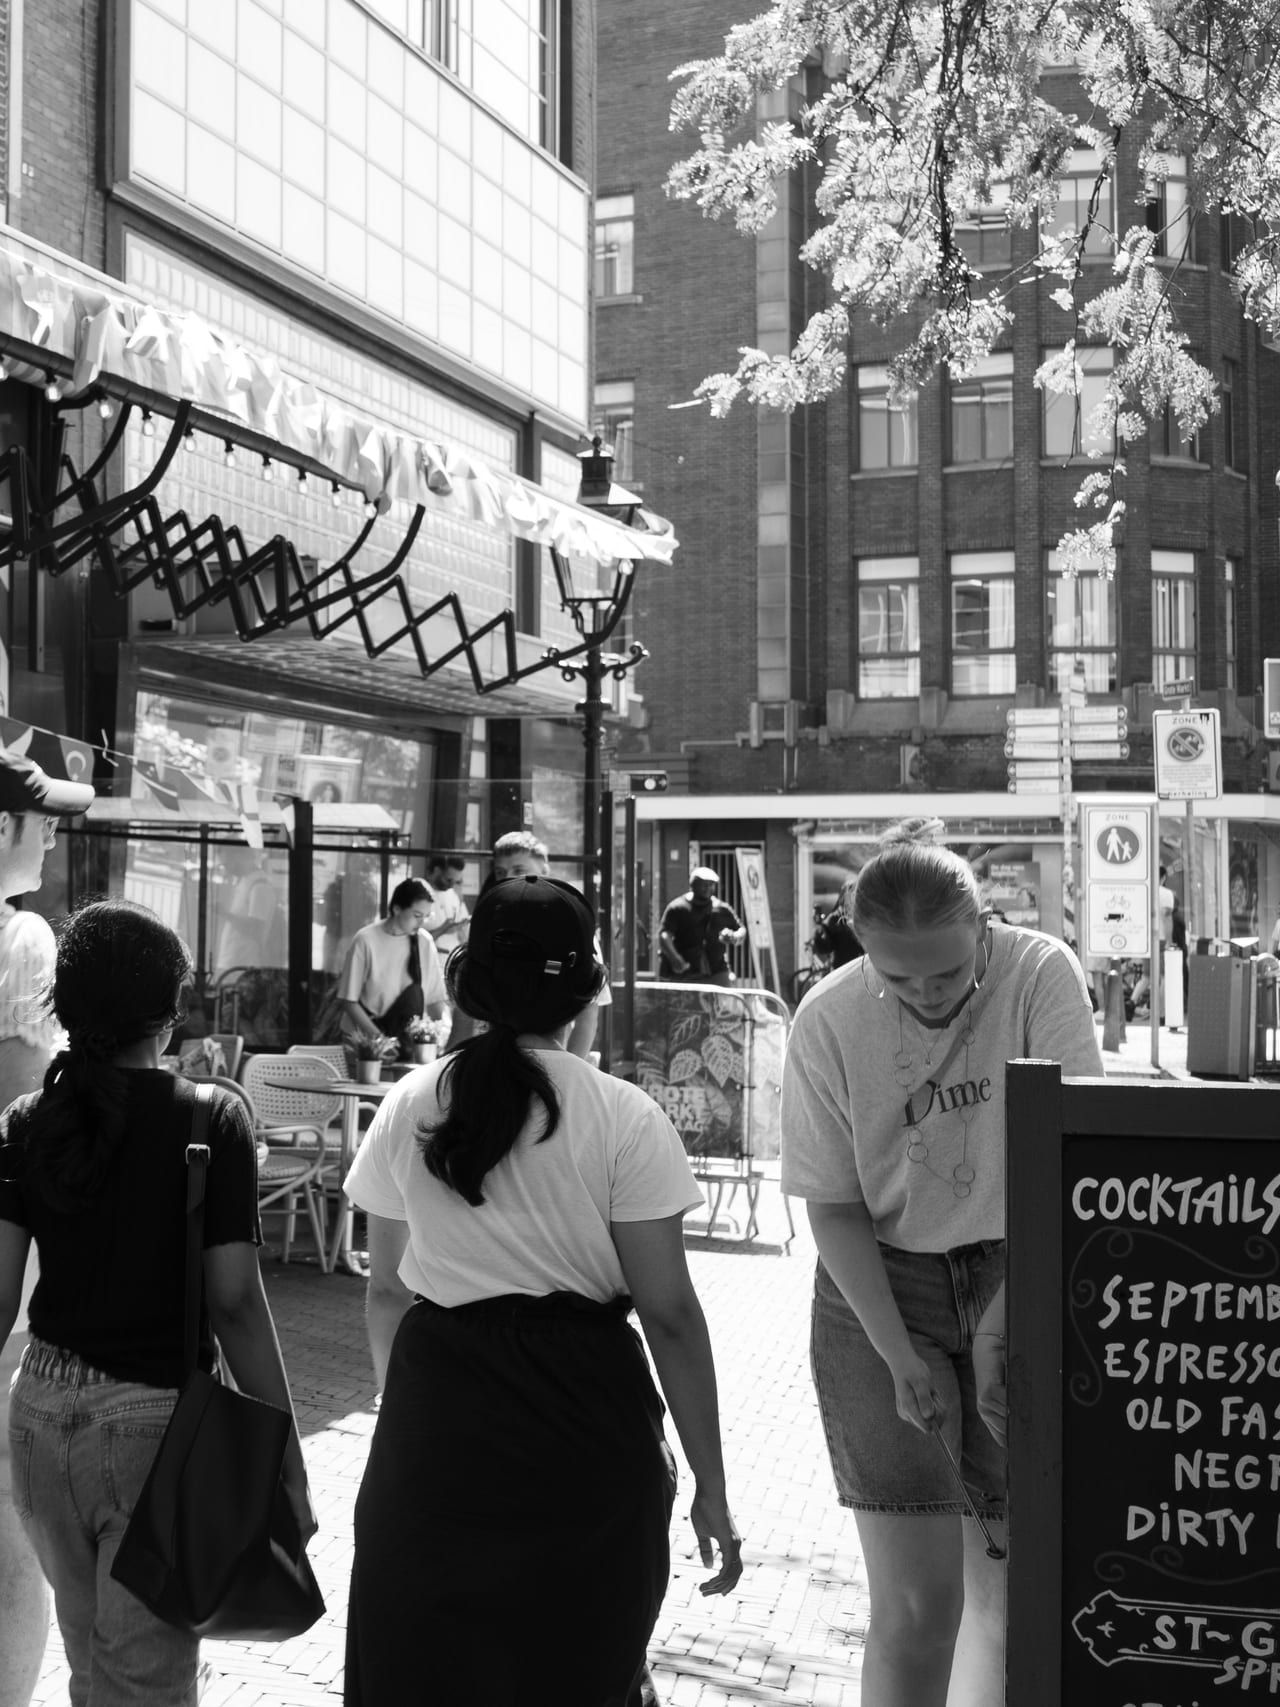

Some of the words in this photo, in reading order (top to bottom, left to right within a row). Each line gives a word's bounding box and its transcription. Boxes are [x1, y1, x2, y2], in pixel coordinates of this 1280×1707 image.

[1172, 716, 1198, 725] ZONE
[1105, 813, 1130, 822] ZONE
[640, 1084, 706, 1104] ROTE
[902, 1077, 992, 1127] Dime
[665, 1103, 703, 1120] RKT
[674, 1119, 704, 1132] AAG
[1126, 1396, 1202, 1434] OLD
